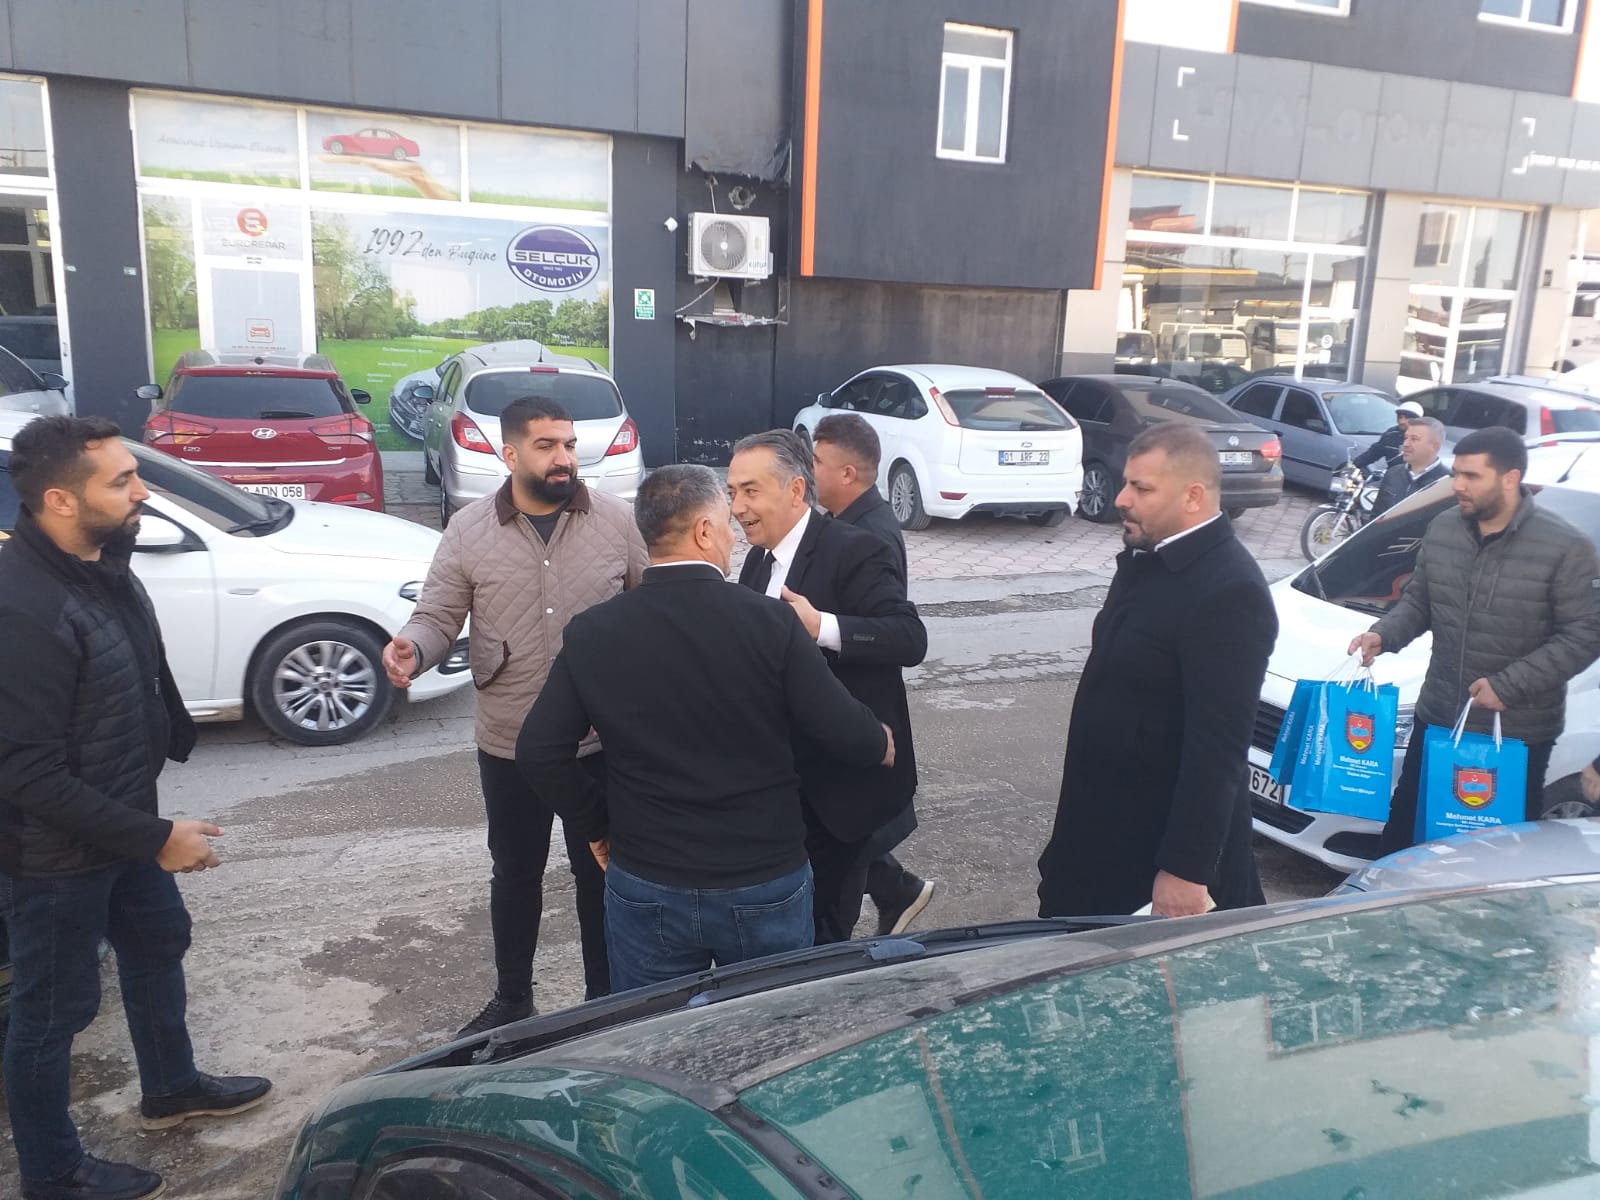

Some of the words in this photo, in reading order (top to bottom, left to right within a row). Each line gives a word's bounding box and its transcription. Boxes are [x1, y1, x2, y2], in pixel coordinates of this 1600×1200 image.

[515, 251, 592, 266] SELÇUK
[523, 268, 584, 286] OTOMOTİV
[281, 486, 303, 498] 058
[1252, 770, 1279, 801] 672
[1445, 811, 1476, 821] Mehmet
[1478, 815, 1502, 825] KARA
